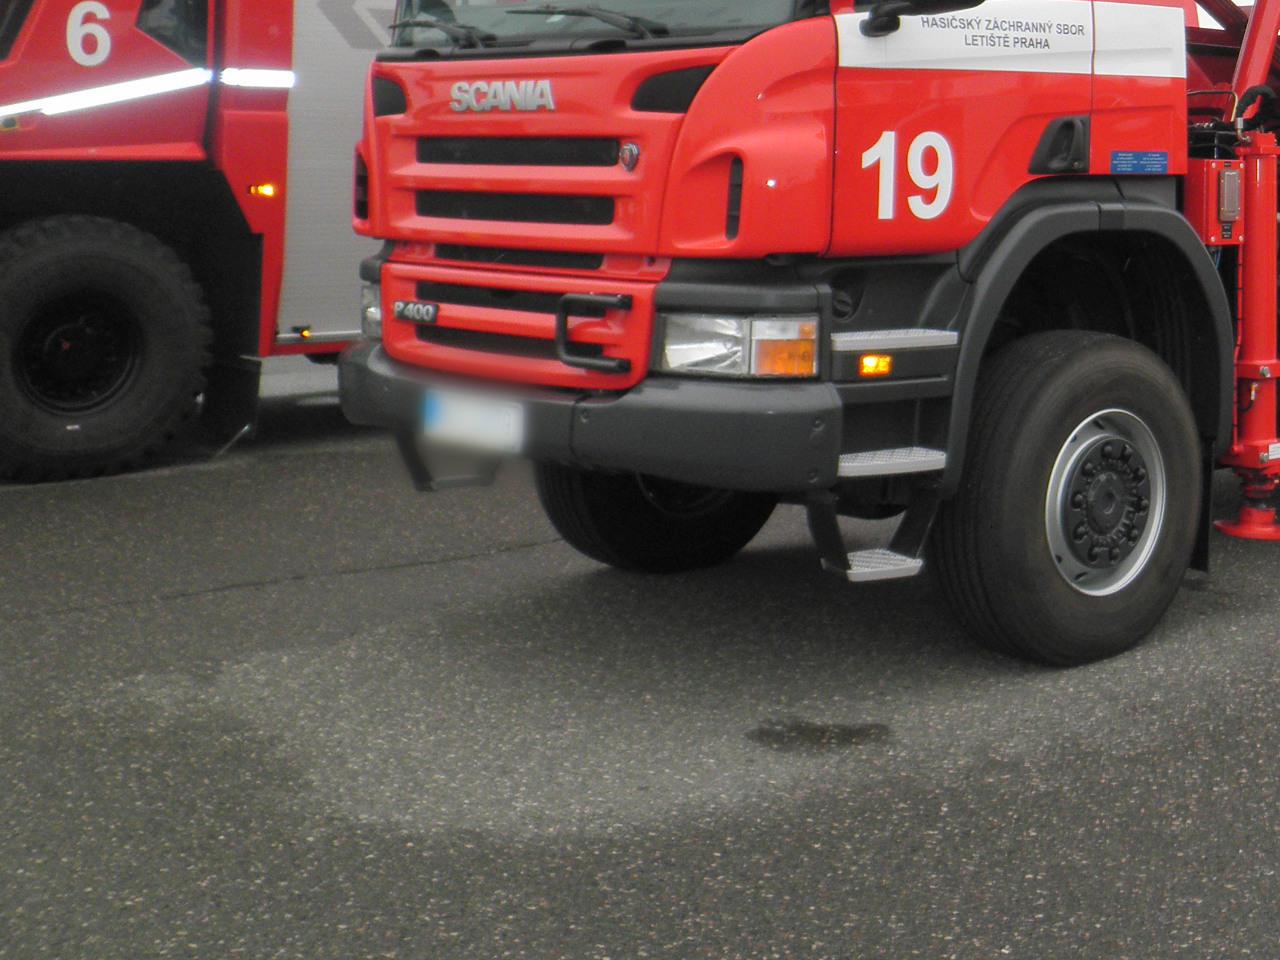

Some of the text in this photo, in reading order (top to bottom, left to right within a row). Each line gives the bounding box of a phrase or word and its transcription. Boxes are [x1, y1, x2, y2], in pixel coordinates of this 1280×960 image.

[66, 0, 112, 67] 6
[921, 15, 1085, 36] HASIČSKÝ ZÁCHRANNÝ SBOR
[964, 33, 1051, 50] LETIŠTĚ PRAHA
[450, 79, 556, 112] SCANIA
[861, 130, 954, 220] 19
